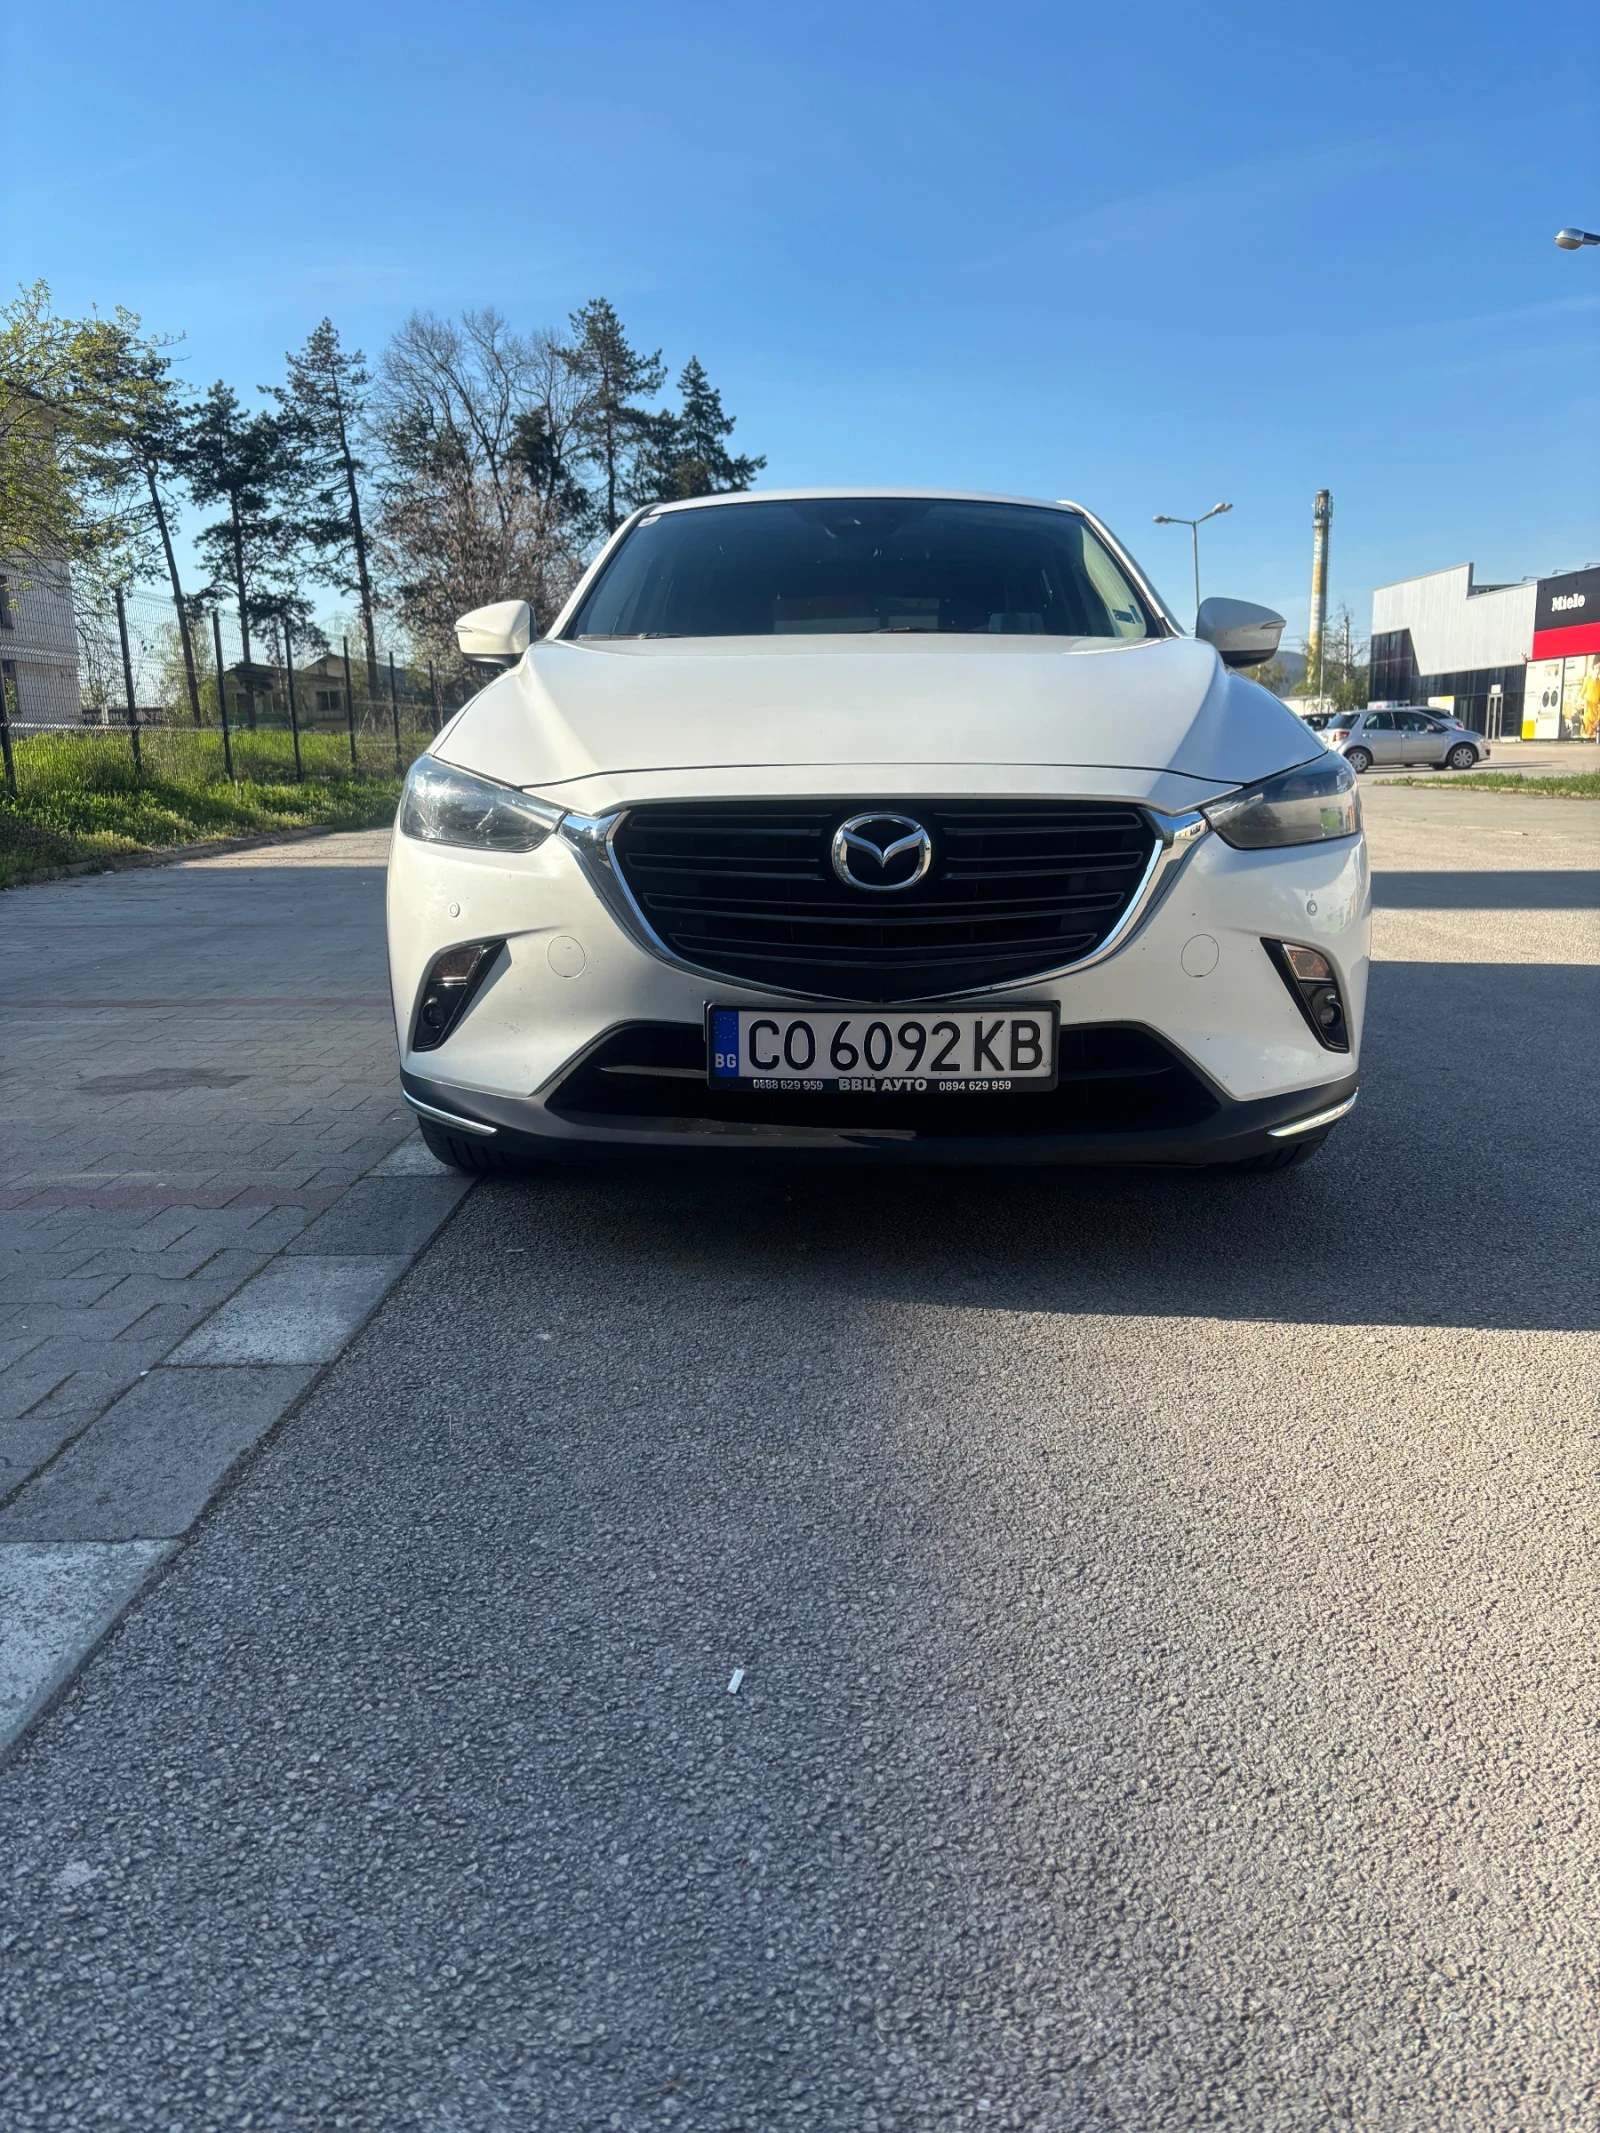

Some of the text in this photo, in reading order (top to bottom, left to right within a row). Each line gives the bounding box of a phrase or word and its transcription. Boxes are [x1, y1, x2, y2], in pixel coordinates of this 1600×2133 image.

[1551, 593, 1585, 612] Miele
[829, 1020, 962, 1072] 6092
[714, 1053, 737, 1068] BG
[753, 1078, 1012, 1092] 0888 629 959 ВВЦ АУТО 0894 629 959
